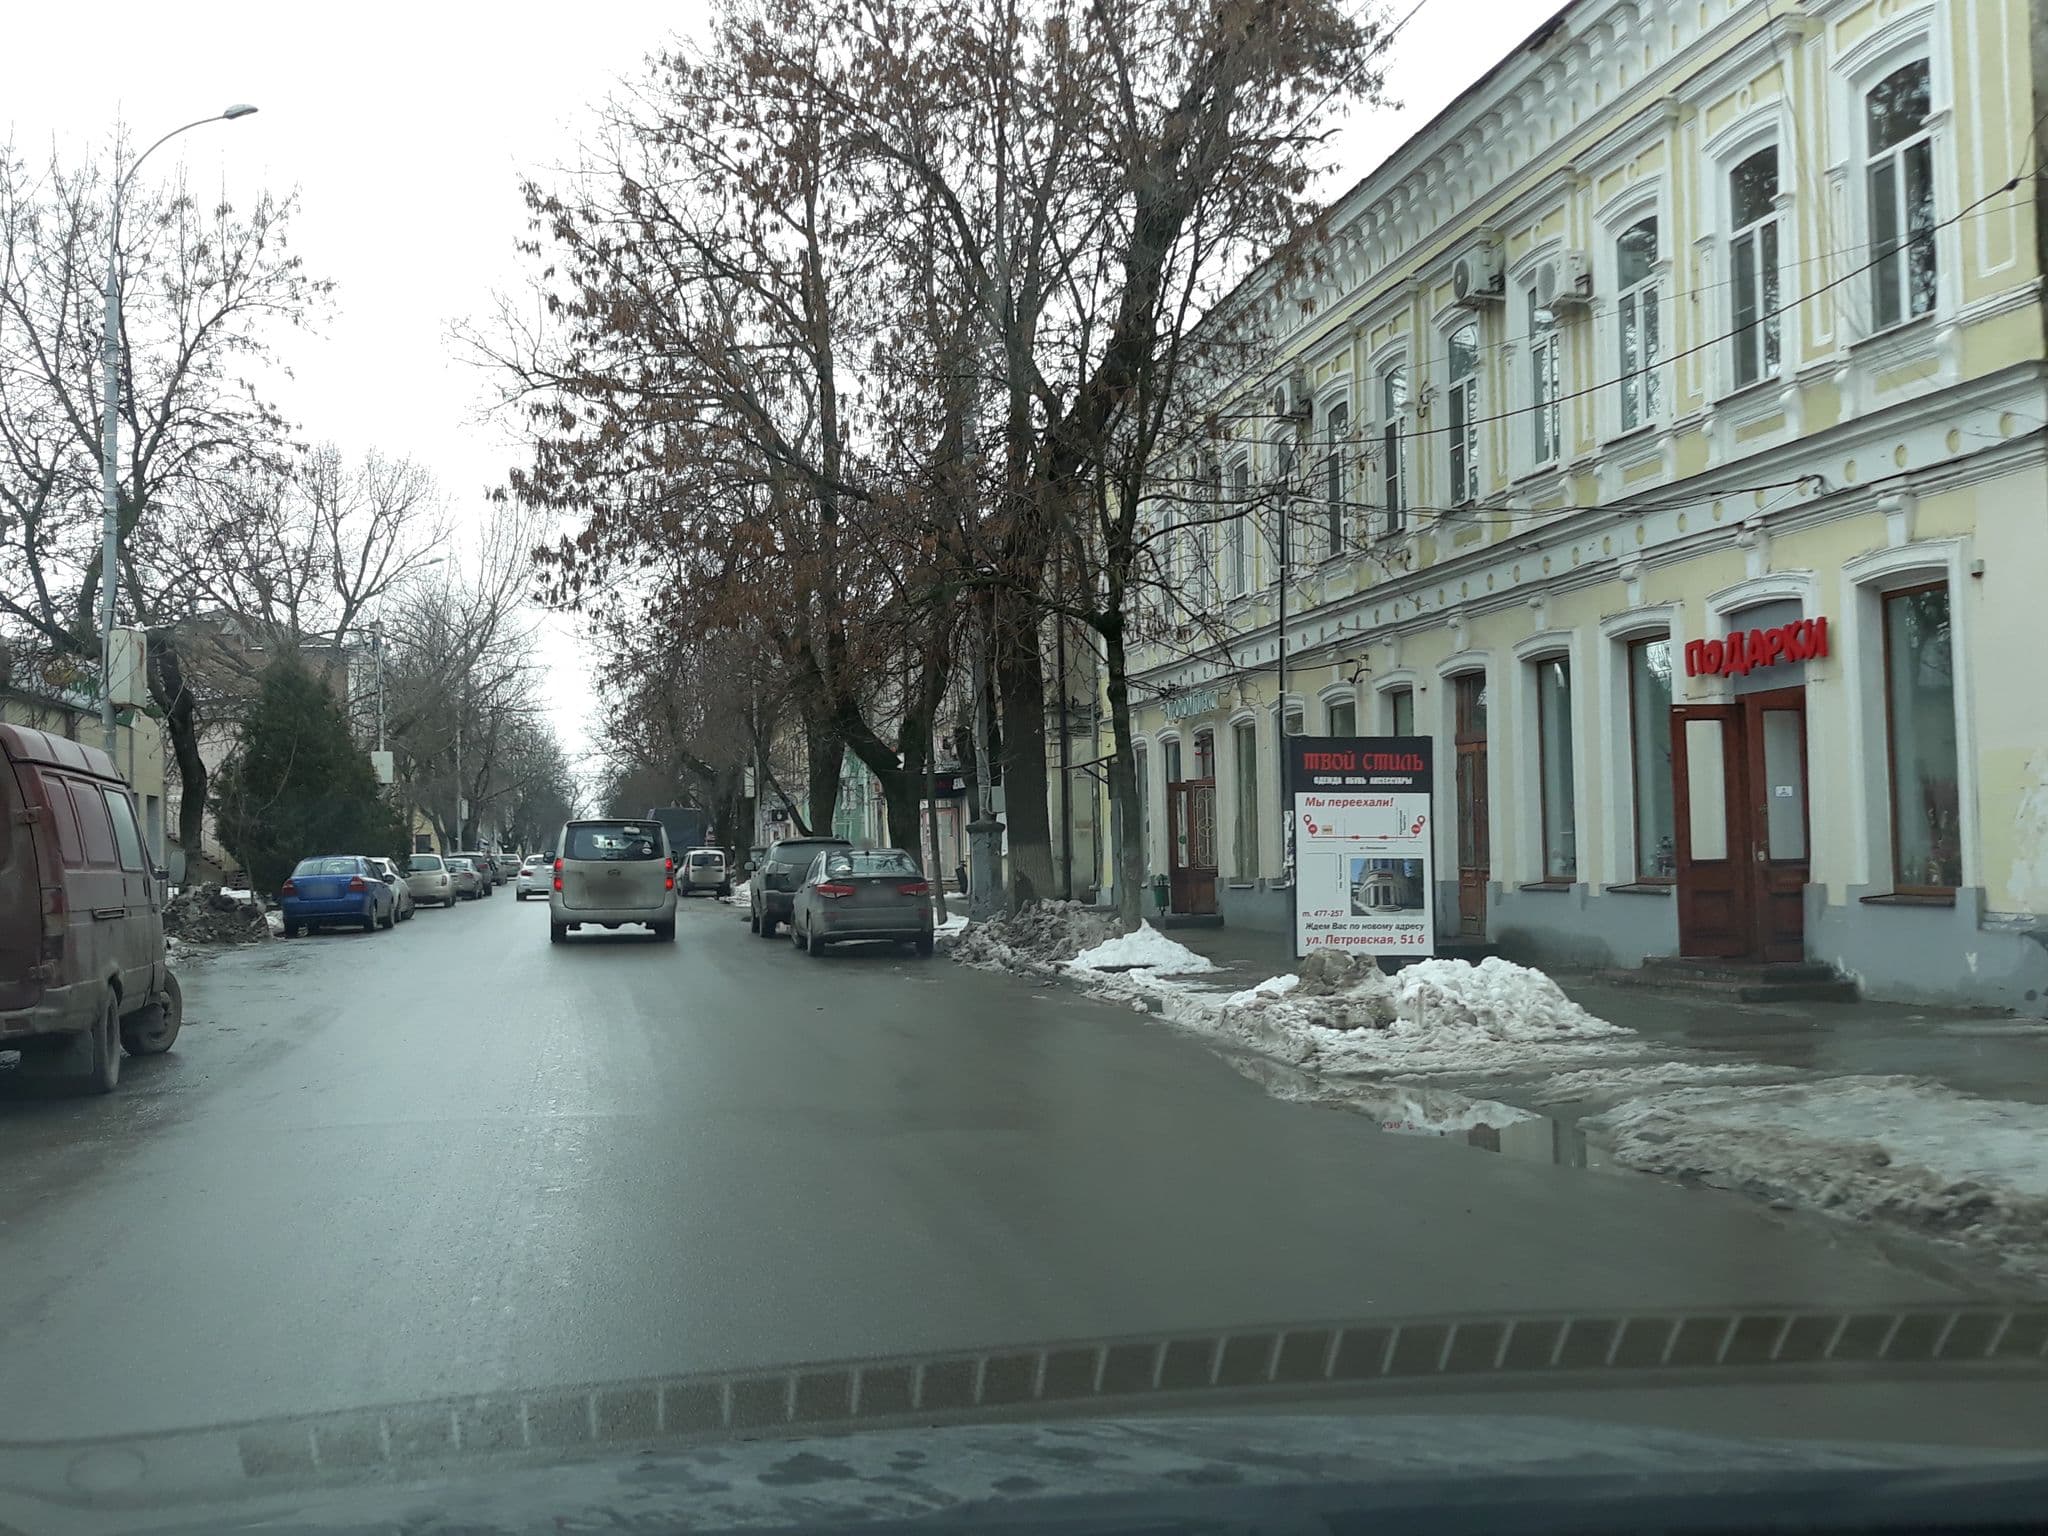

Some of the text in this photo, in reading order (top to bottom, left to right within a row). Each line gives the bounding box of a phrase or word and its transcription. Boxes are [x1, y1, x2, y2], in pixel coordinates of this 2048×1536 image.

[1685, 616, 1828, 678] ПОДАРКИ
[1305, 797, 1394, 808] Мы переехали!
[1305, 922, 1330, 930] Ждем
[1332, 922, 1347, 930] Вас
[1306, 936, 1322, 946] ул.
[1325, 934, 1397, 946] Петровская,
[1400, 934, 1415, 944] 51
